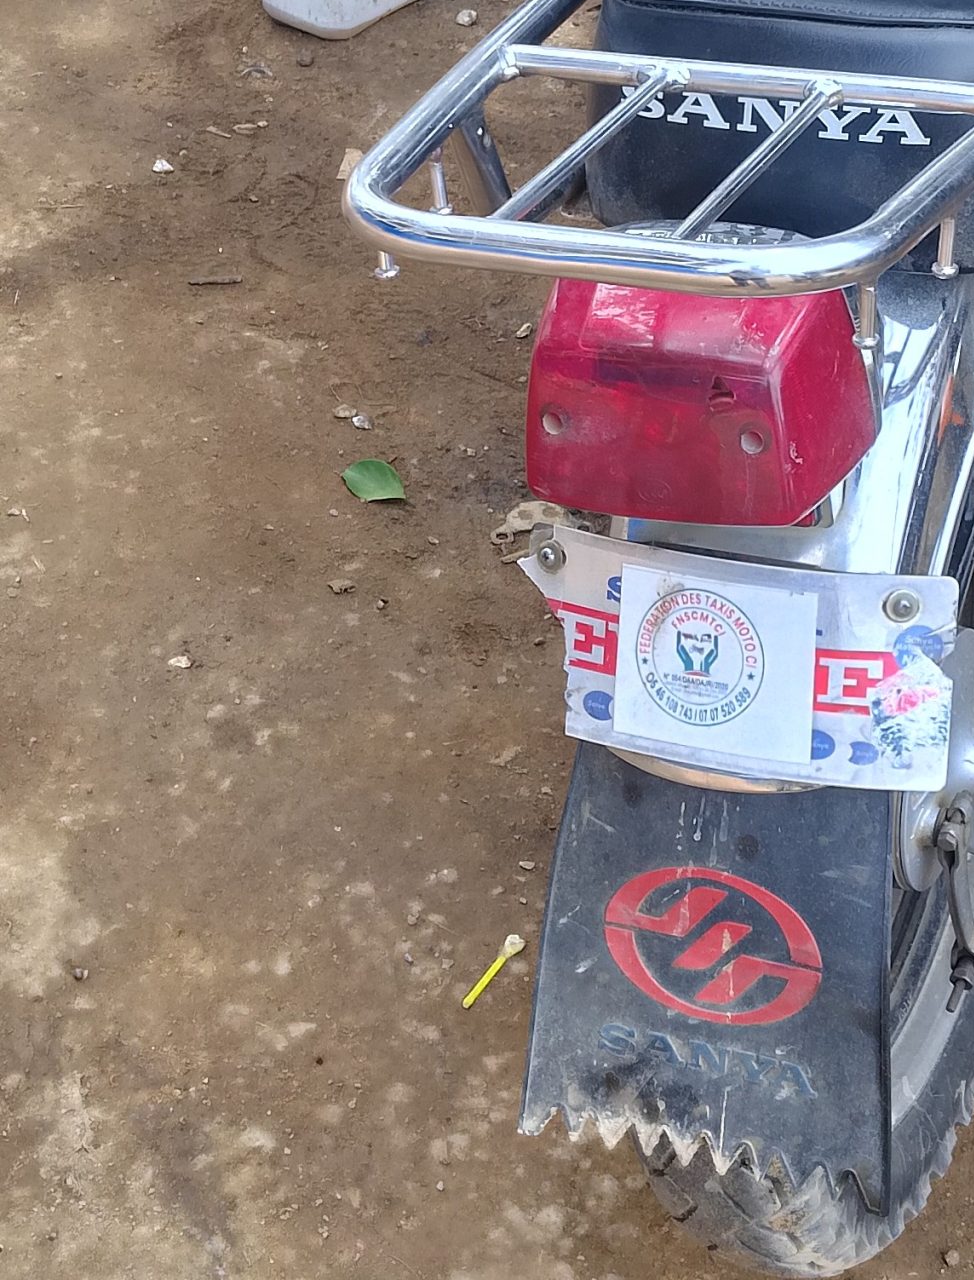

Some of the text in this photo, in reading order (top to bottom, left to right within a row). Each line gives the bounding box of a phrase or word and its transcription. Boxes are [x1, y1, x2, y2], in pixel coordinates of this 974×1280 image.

[620, 85, 931, 146] SANYA
[681, 593, 701, 605] DES
[705, 595, 735, 620] TAXIS
[732, 617, 756, 652] MOTO
[710, 709, 719, 722] 07
[721, 701, 736, 718] 520
[735, 687, 752, 708] 589
[598, 1023, 819, 1101] SANYA
